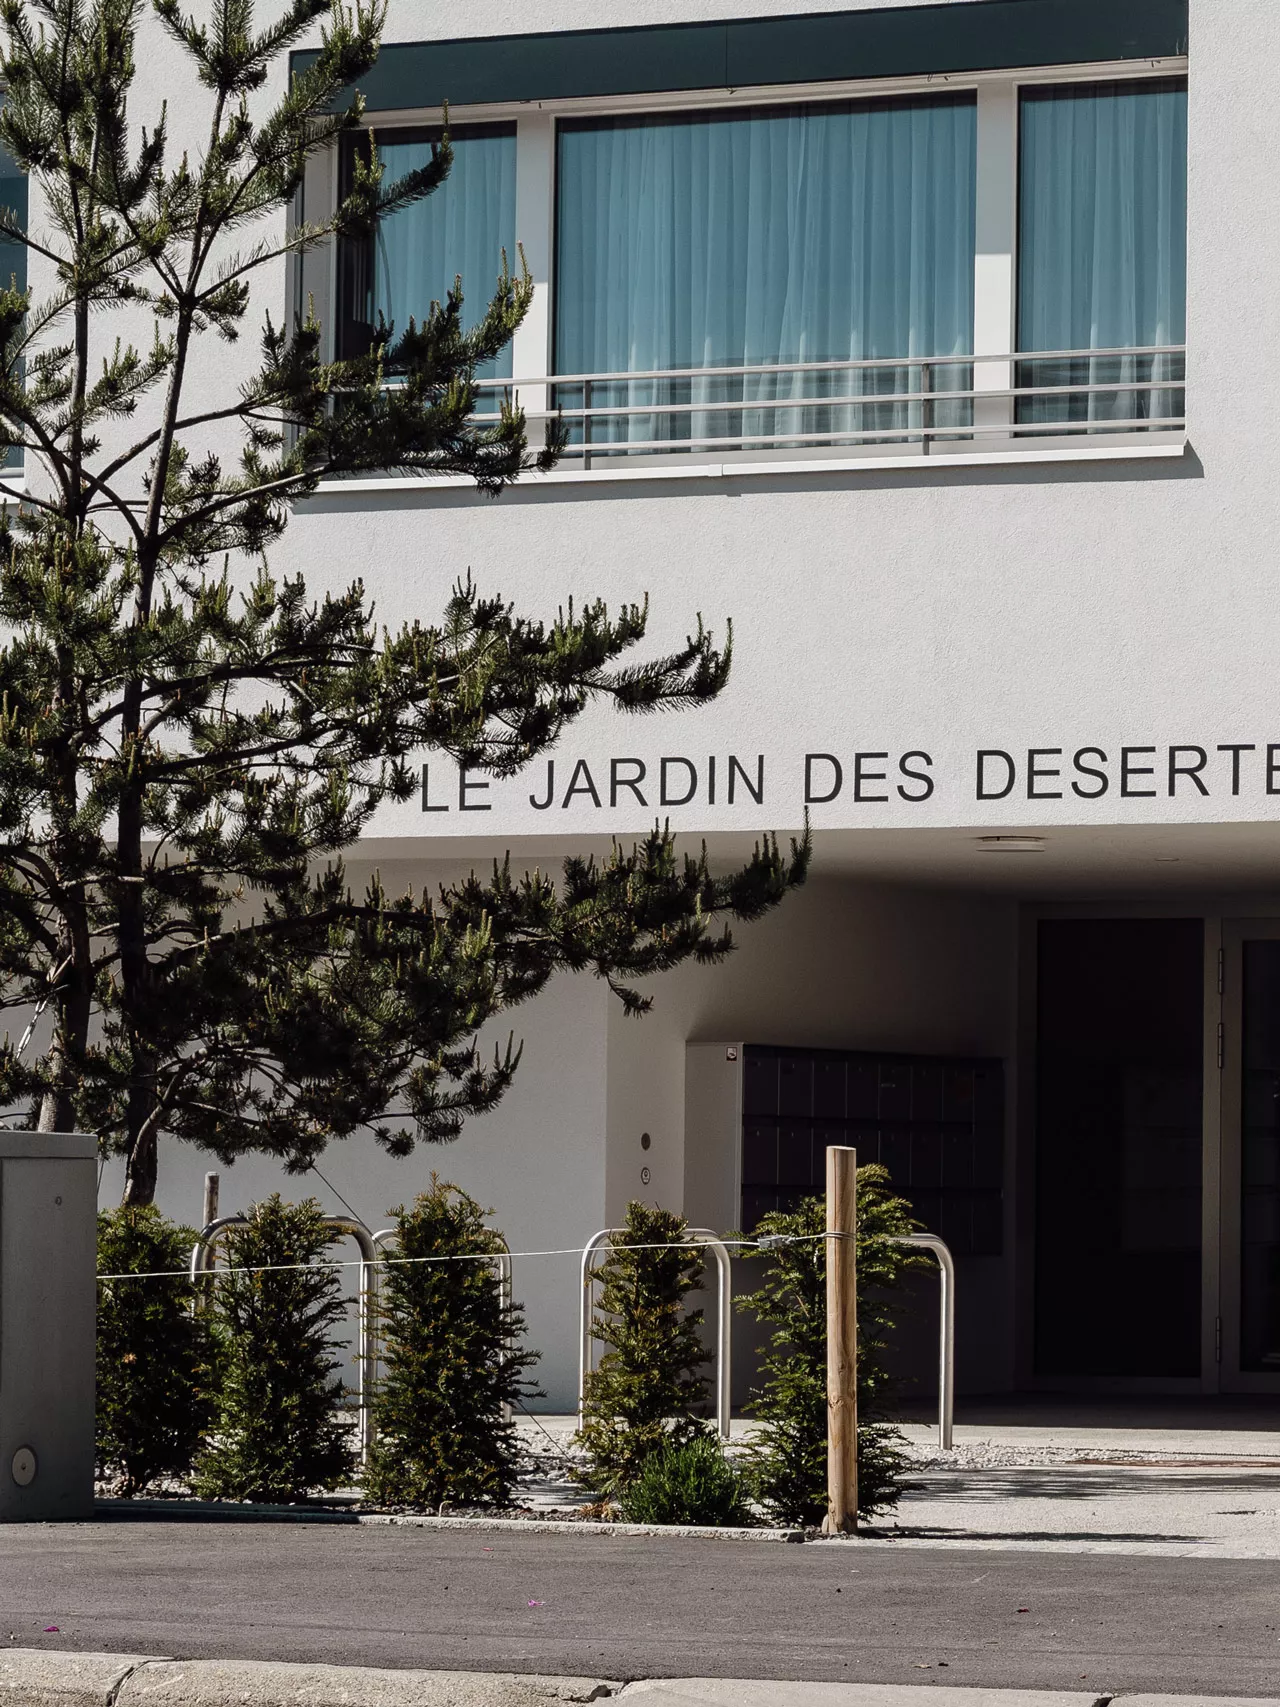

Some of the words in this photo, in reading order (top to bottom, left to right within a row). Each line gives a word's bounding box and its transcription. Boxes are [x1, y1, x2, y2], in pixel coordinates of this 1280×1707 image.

[422, 763, 492, 812] LE
[529, 754, 765, 811] JARDIN
[804, 746, 935, 804] DES
